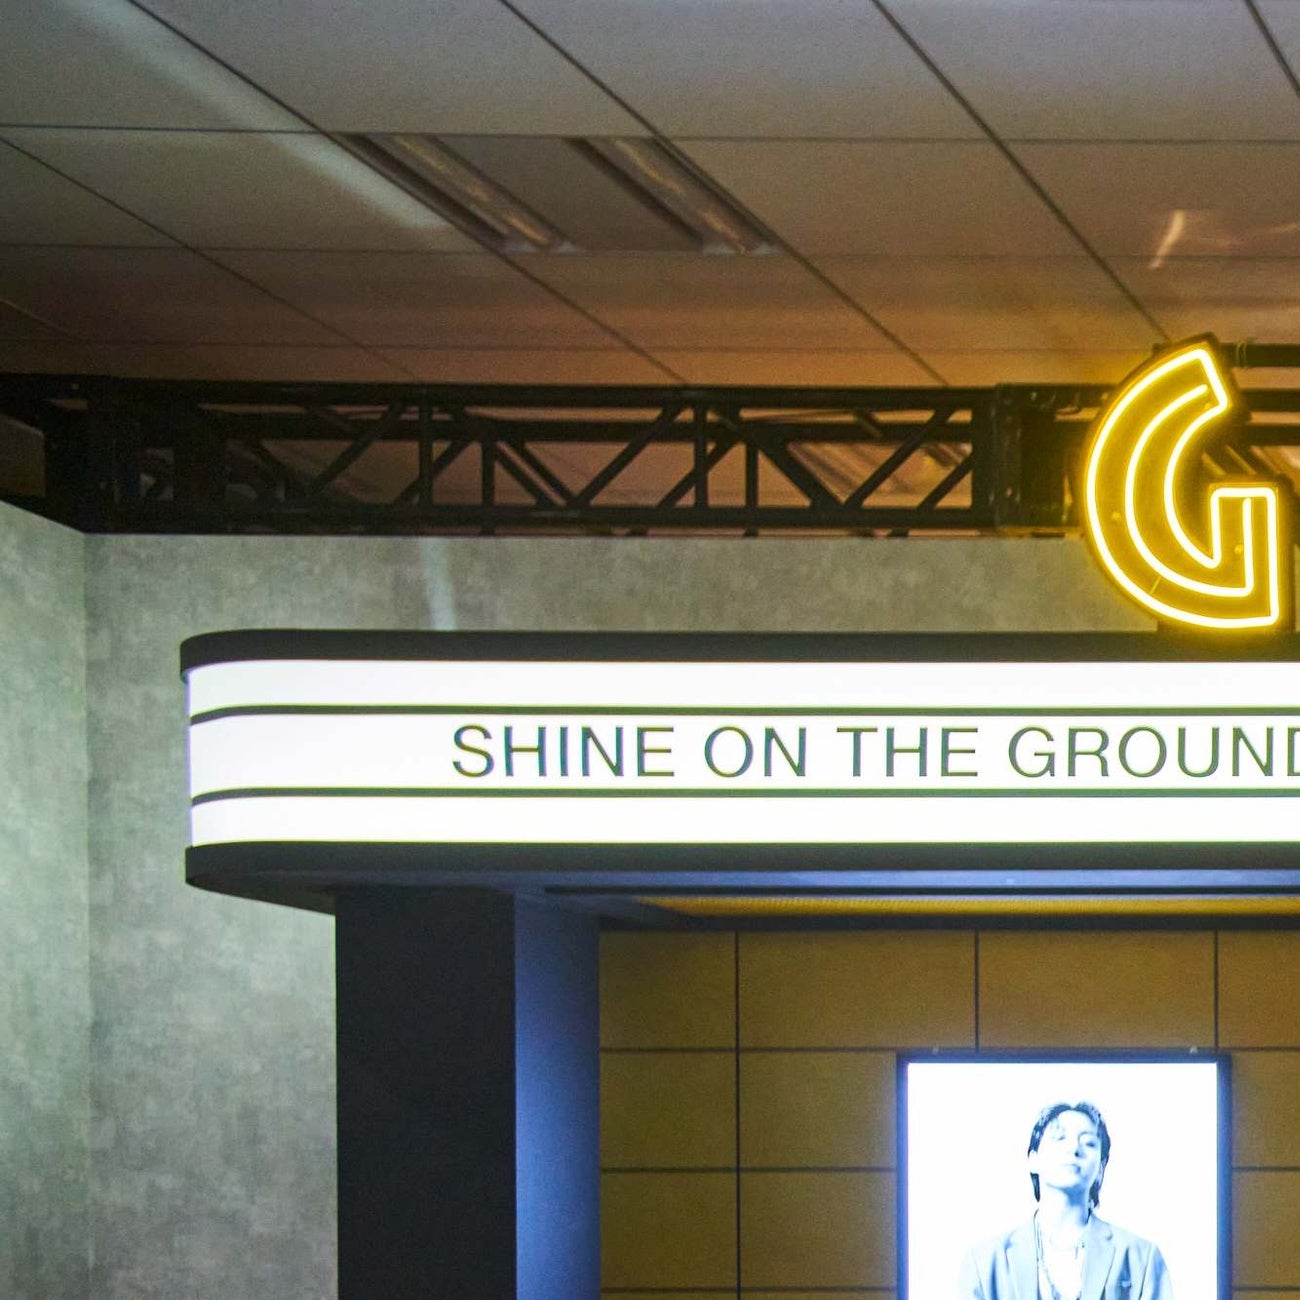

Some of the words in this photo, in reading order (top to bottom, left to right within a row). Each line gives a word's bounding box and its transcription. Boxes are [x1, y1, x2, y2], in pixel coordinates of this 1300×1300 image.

[451, 725, 676, 779] SHINE
[703, 725, 807, 779] ON
[835, 726, 980, 778] THE
